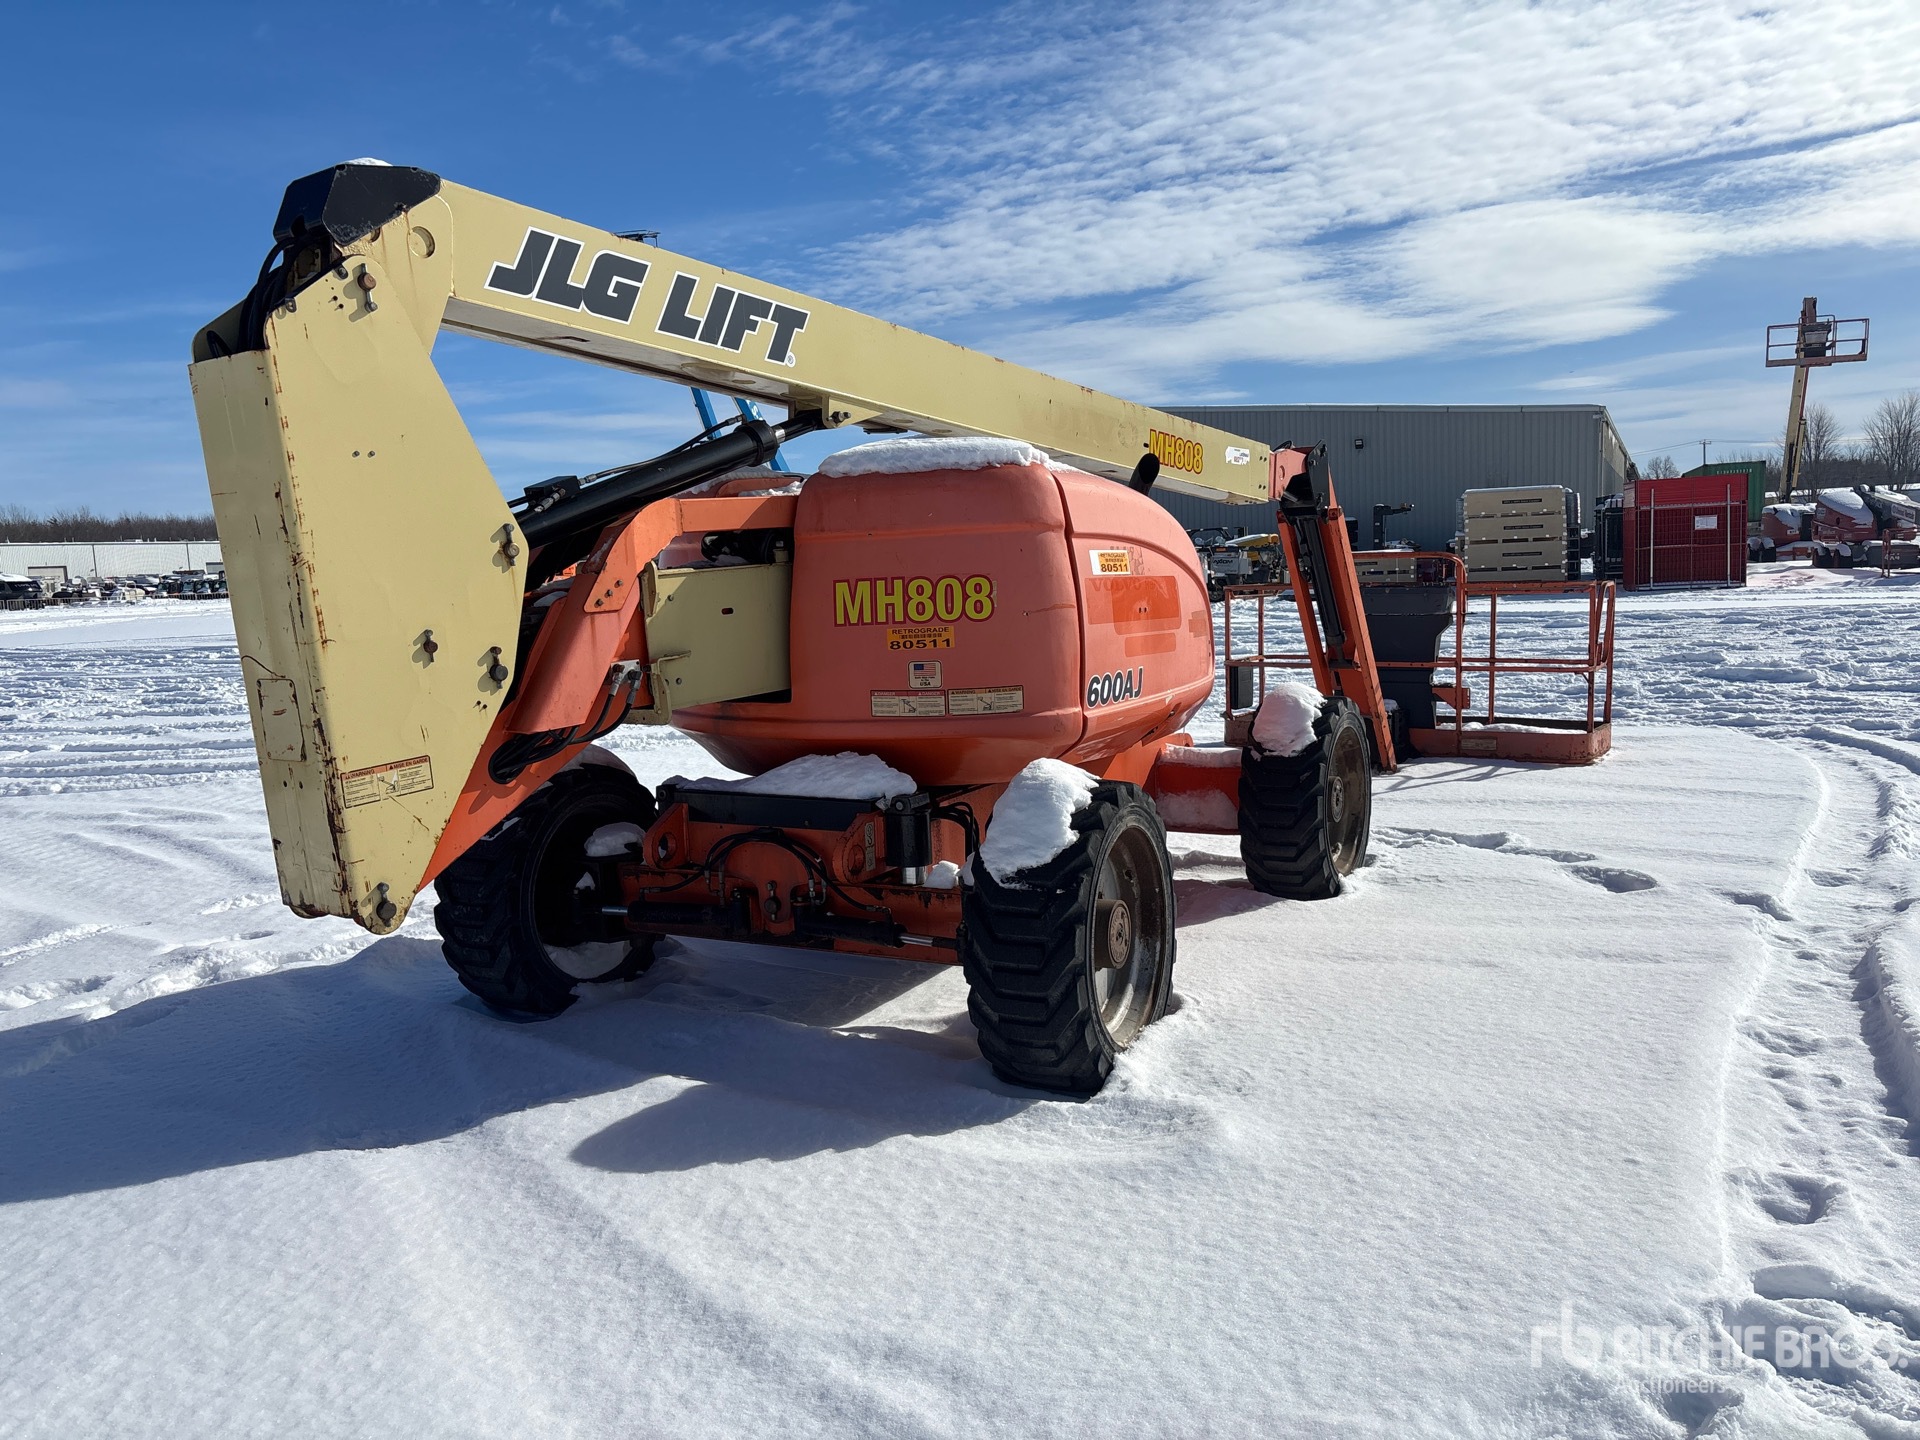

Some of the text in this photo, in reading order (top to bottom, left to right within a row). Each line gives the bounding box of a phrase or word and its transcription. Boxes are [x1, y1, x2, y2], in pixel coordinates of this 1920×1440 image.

[484, 226, 811, 365] JLG LIFT
[1149, 428, 1204, 474] MH808
[1100, 563, 1128, 573] 80511
[833, 574, 993, 627] MH808
[889, 638, 951, 650] 80511
[892, 627, 950, 635] RETROGRADE
[1087, 667, 1143, 709] 600AJ
